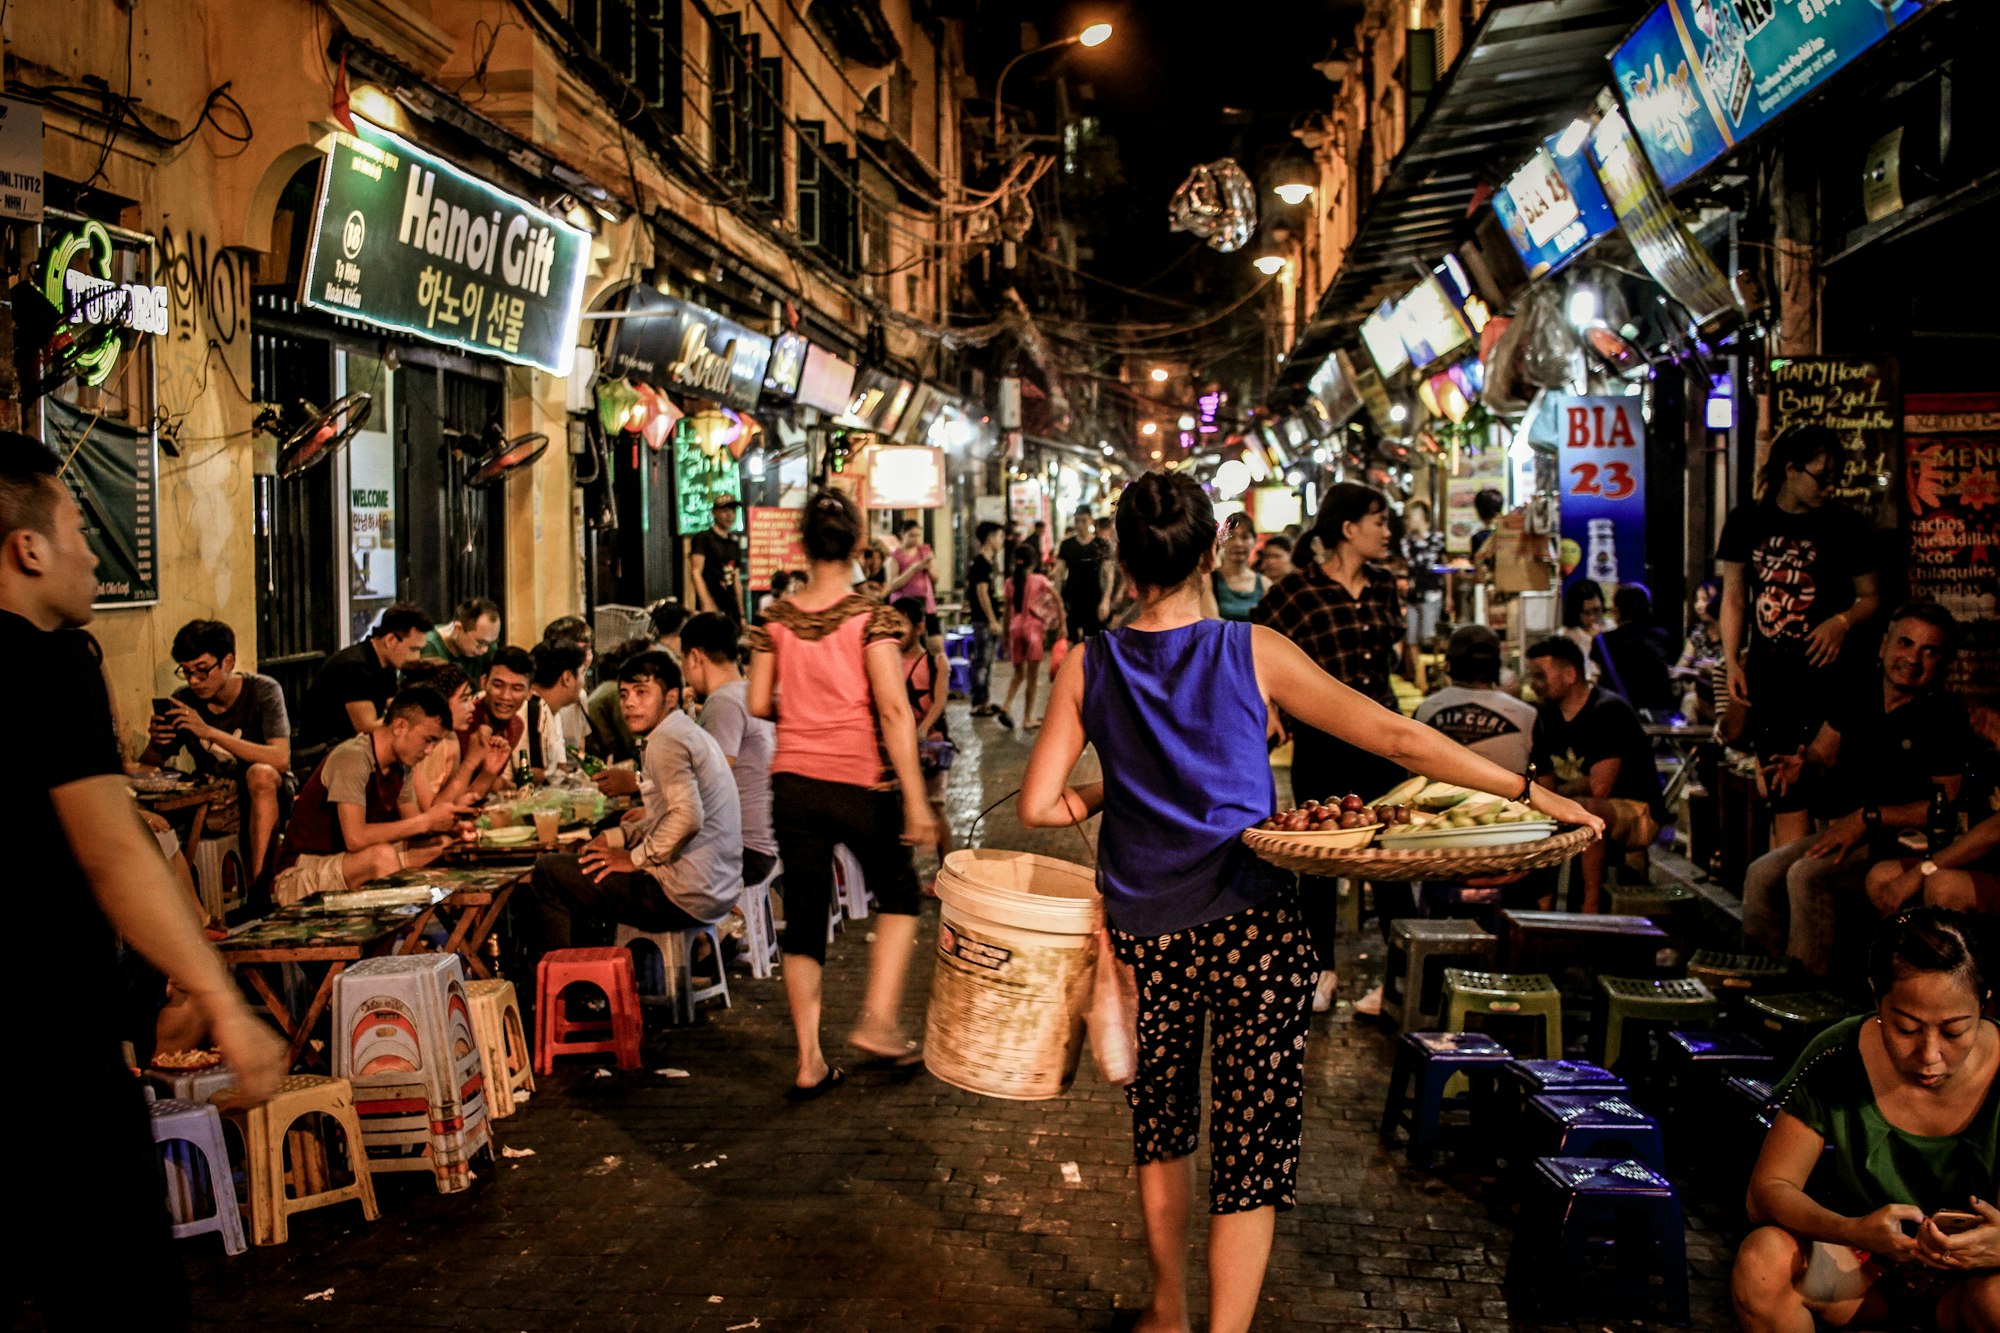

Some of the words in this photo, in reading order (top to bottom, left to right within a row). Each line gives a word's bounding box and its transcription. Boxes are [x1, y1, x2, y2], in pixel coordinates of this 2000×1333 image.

[346, 222, 362, 250] 18
[399, 163, 501, 276] Hanoi
[502, 214, 555, 298] Gift
[418, 265, 484, 341] 하노이
[486, 291, 526, 354] 선물
[1778, 388, 1826, 416] Buy
[1825, 386, 1843, 409] 2
[1566, 404, 1636, 449] BIA
[1933, 447, 2000, 468] MEN
[1569, 460, 1636, 500] 23
[352, 488, 389, 508] WELCOME
[1435, 711, 1463, 727] RIP
[1465, 712, 1507, 733] CURL
